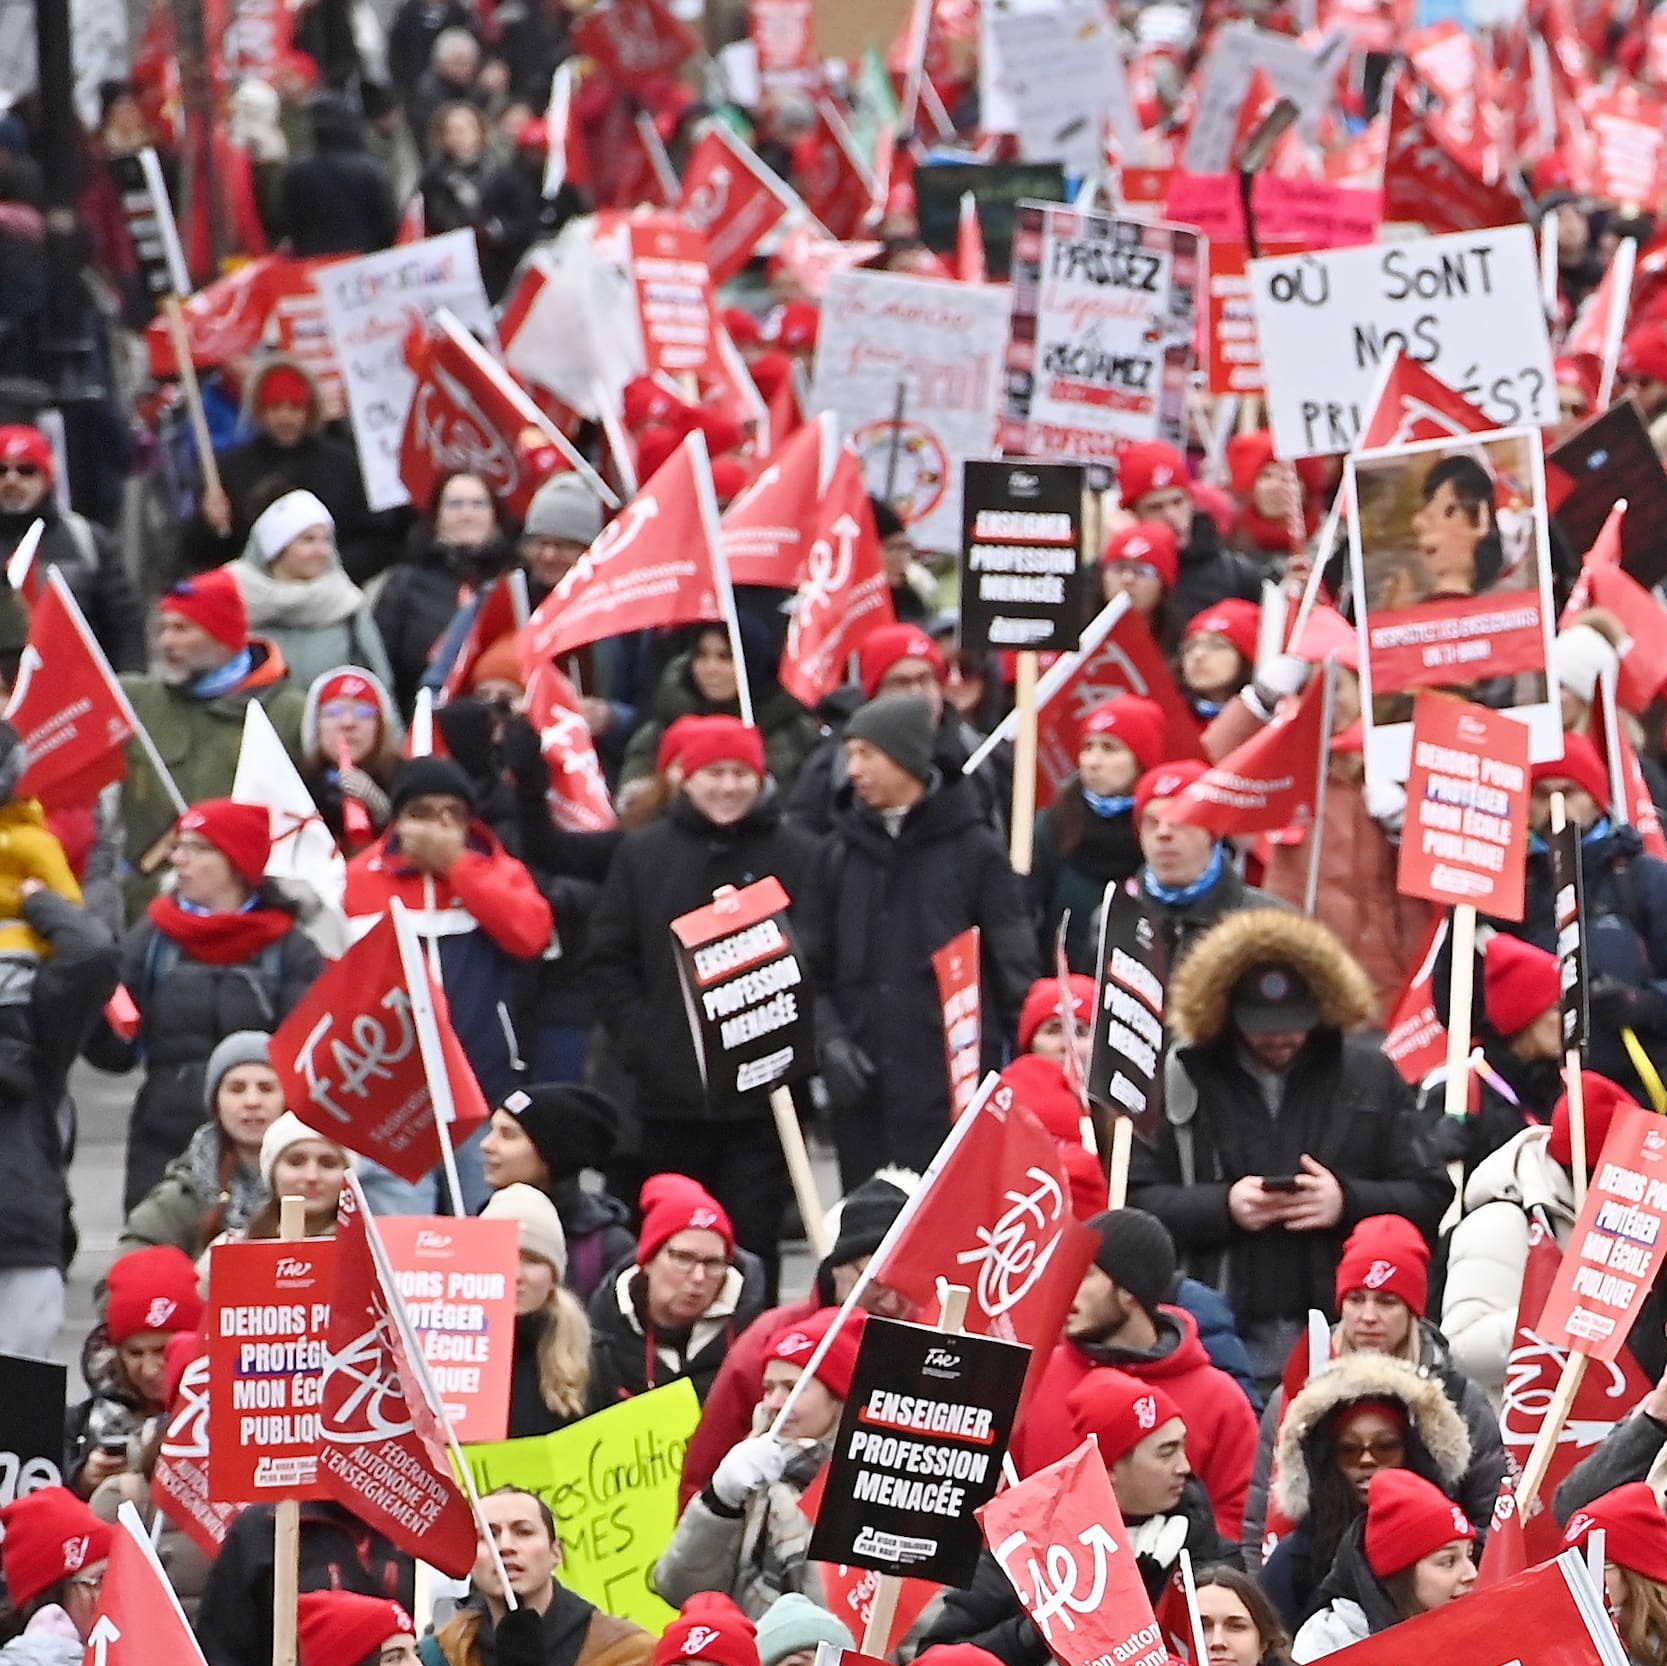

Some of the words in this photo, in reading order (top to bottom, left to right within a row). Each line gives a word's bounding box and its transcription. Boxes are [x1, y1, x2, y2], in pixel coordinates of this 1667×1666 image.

[1270, 257, 1328, 305] OÙ
[702, 955, 801, 1021] PROFESSION
[448, 1273, 505, 1298] POUR
[221, 1305, 306, 1337] DEHORS
[425, 1332, 489, 1361] ÉCOLE
[234, 1378, 285, 1409] MON
[867, 1390, 993, 1439] ENSEIGNER
[349, 1444, 423, 1505] AUTONOME
[379, 1436, 449, 1500] FÉDÉRATION
[848, 1431, 989, 1483] PROFESSION
[320, 1445, 431, 1537] L'ENSEIGNEMENT
[853, 1471, 965, 1517] MENACÉE
